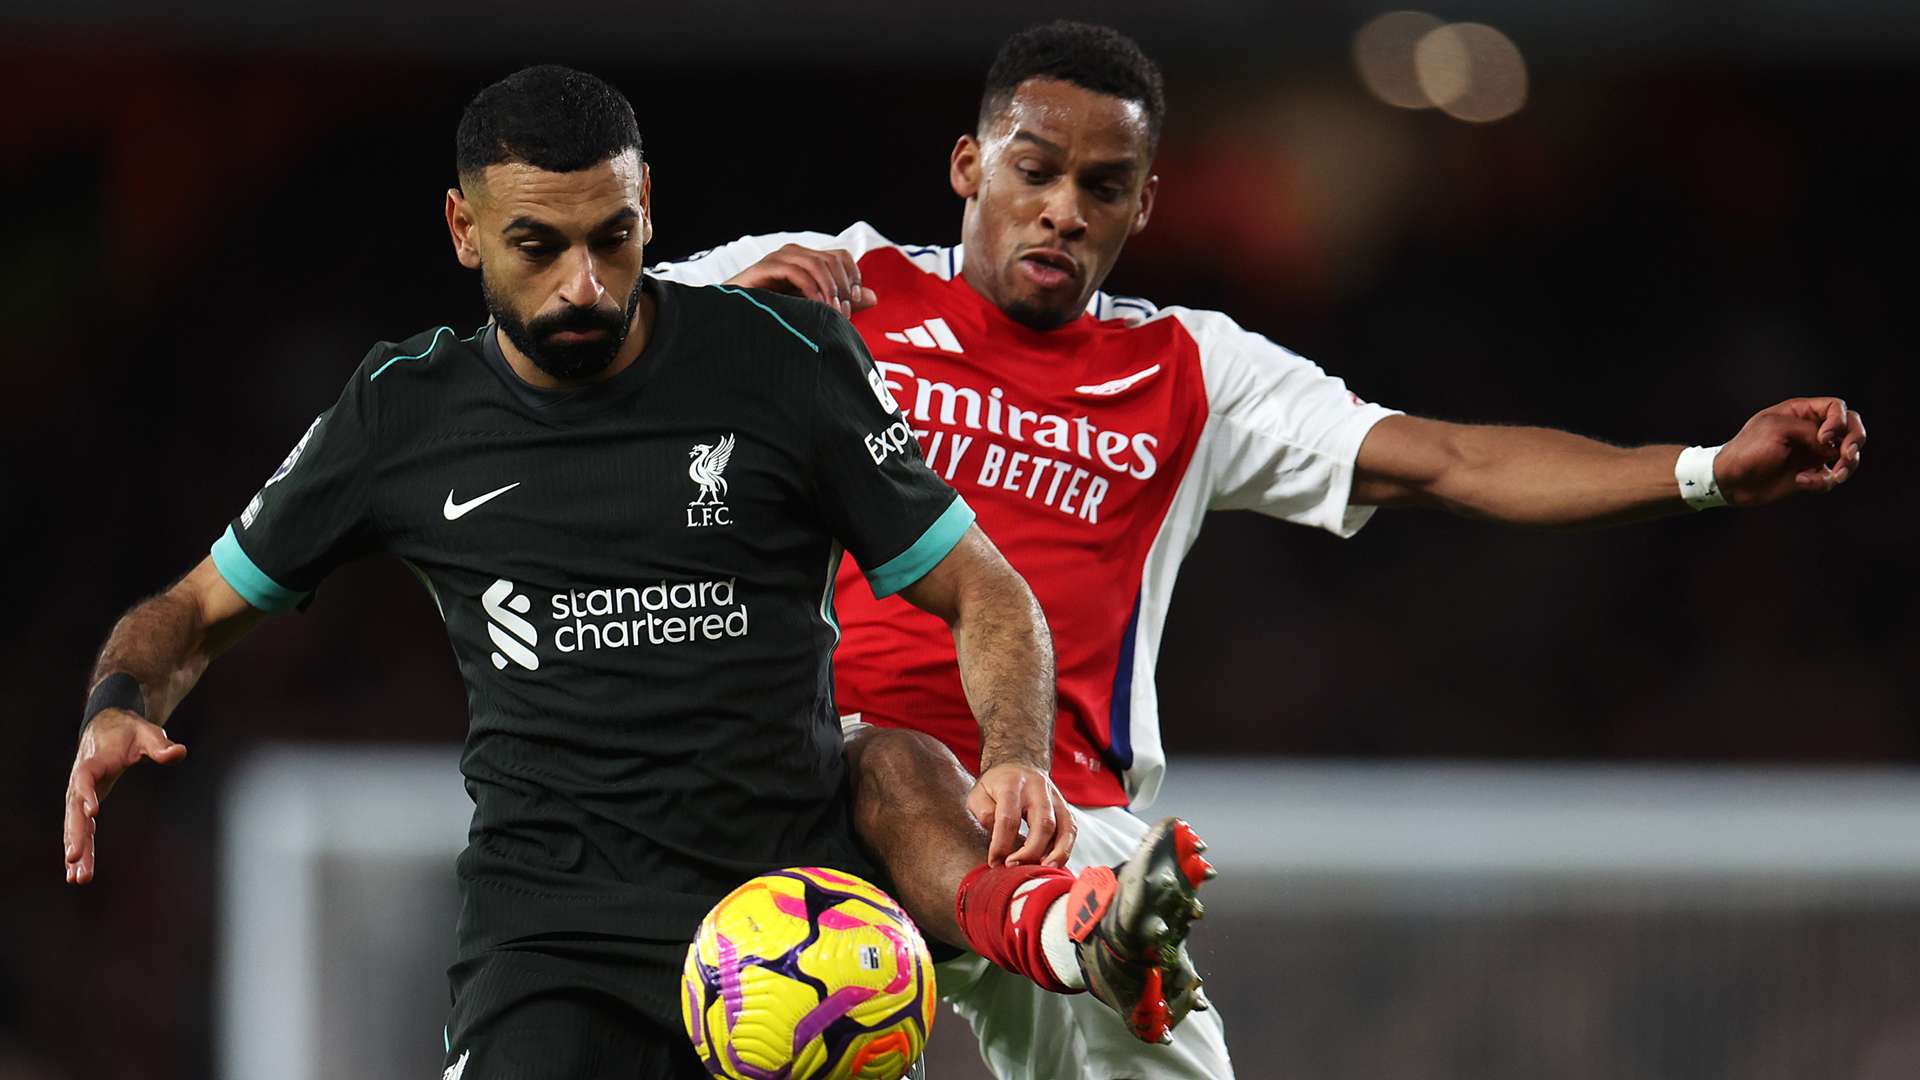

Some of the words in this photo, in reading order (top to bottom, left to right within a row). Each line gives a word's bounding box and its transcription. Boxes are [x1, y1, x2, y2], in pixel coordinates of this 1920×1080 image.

[977, 443, 1109, 524] BETTER
[686, 507, 734, 527] L.F.C.
[551, 577, 735, 620] standard
[554, 604, 748, 651] chartered
